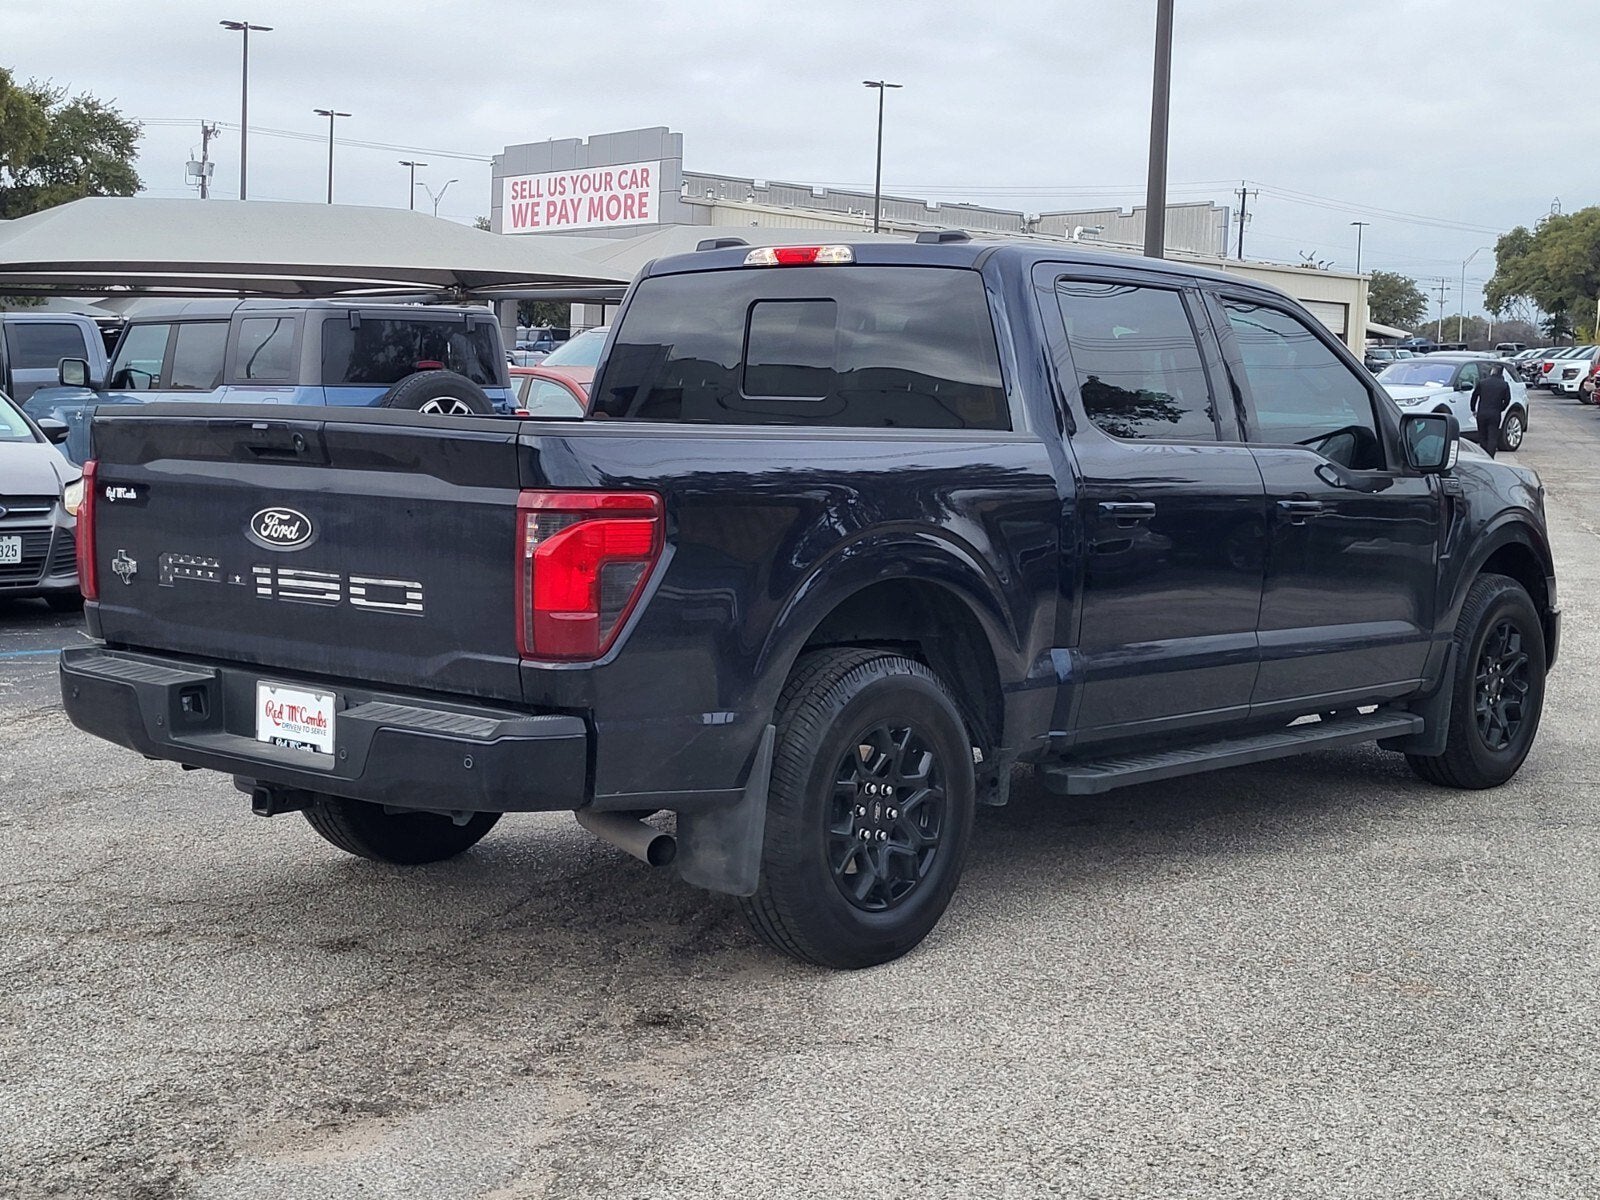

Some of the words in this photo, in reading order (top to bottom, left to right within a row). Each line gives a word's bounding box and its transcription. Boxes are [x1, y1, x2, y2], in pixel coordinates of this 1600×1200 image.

[511, 179, 544, 200] SELL
[547, 176, 567, 197] US
[570, 171, 614, 195] YOUR
[617, 167, 650, 191] CAR
[511, 201, 541, 228] WE
[546, 197, 583, 226] PAY
[587, 191, 650, 223] MORE
[260, 511, 301, 540] Ford
[265, 699, 284, 726] Red
[285, 704, 327, 728] McCombs
[282, 722, 302, 732] DRIVEN
[302, 725, 310, 733] TO
[310, 727, 327, 736] SERVE
